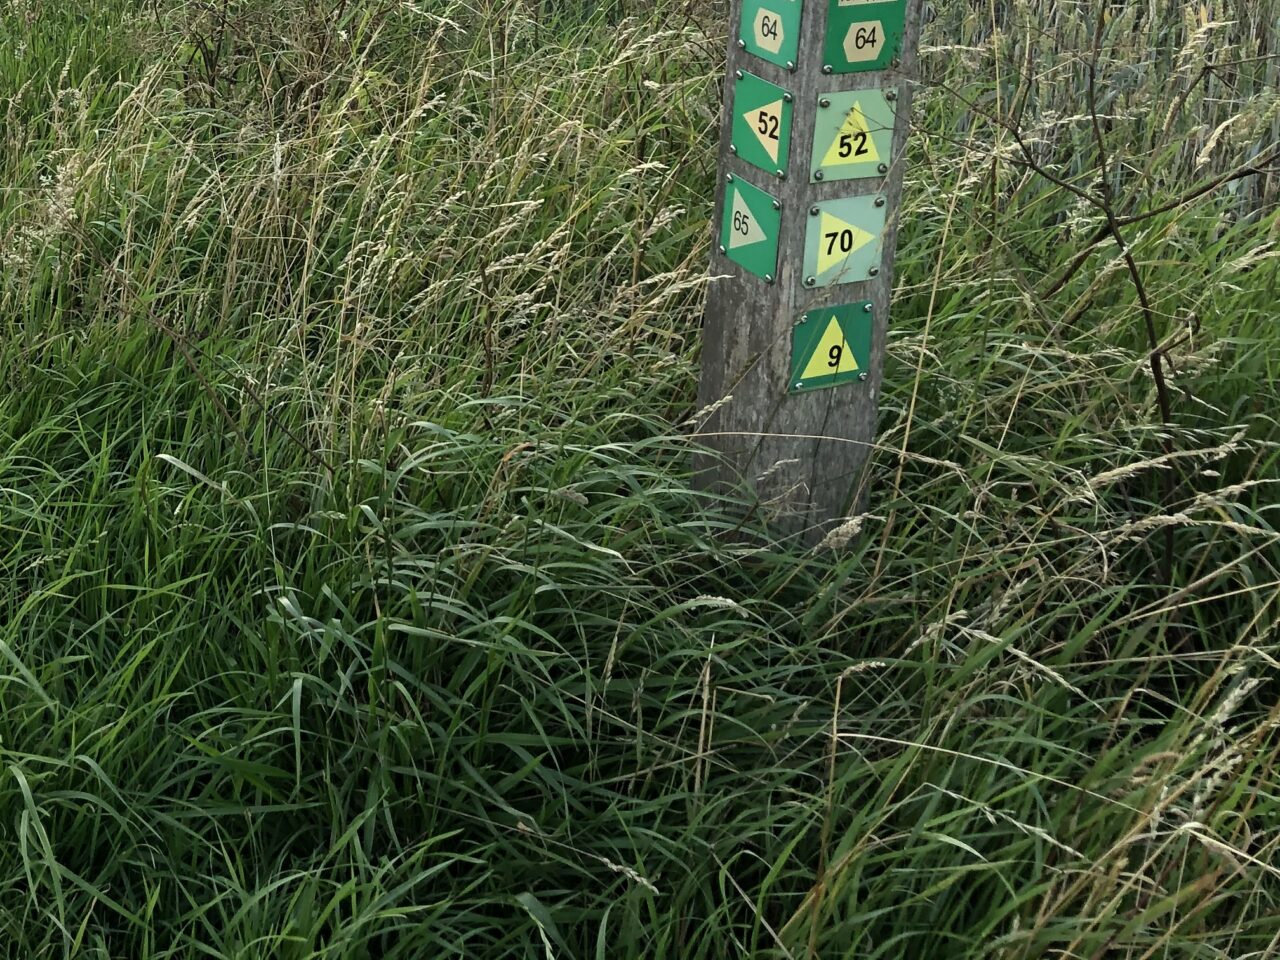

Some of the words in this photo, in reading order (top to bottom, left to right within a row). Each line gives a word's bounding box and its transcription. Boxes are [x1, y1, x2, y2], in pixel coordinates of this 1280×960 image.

[761, 15, 778, 41] 64
[855, 27, 877, 49] 64
[757, 111, 779, 140] 52
[838, 132, 868, 158] 52
[733, 210, 749, 235] 65
[825, 229, 853, 255] 70
[827, 345, 842, 367] 9
